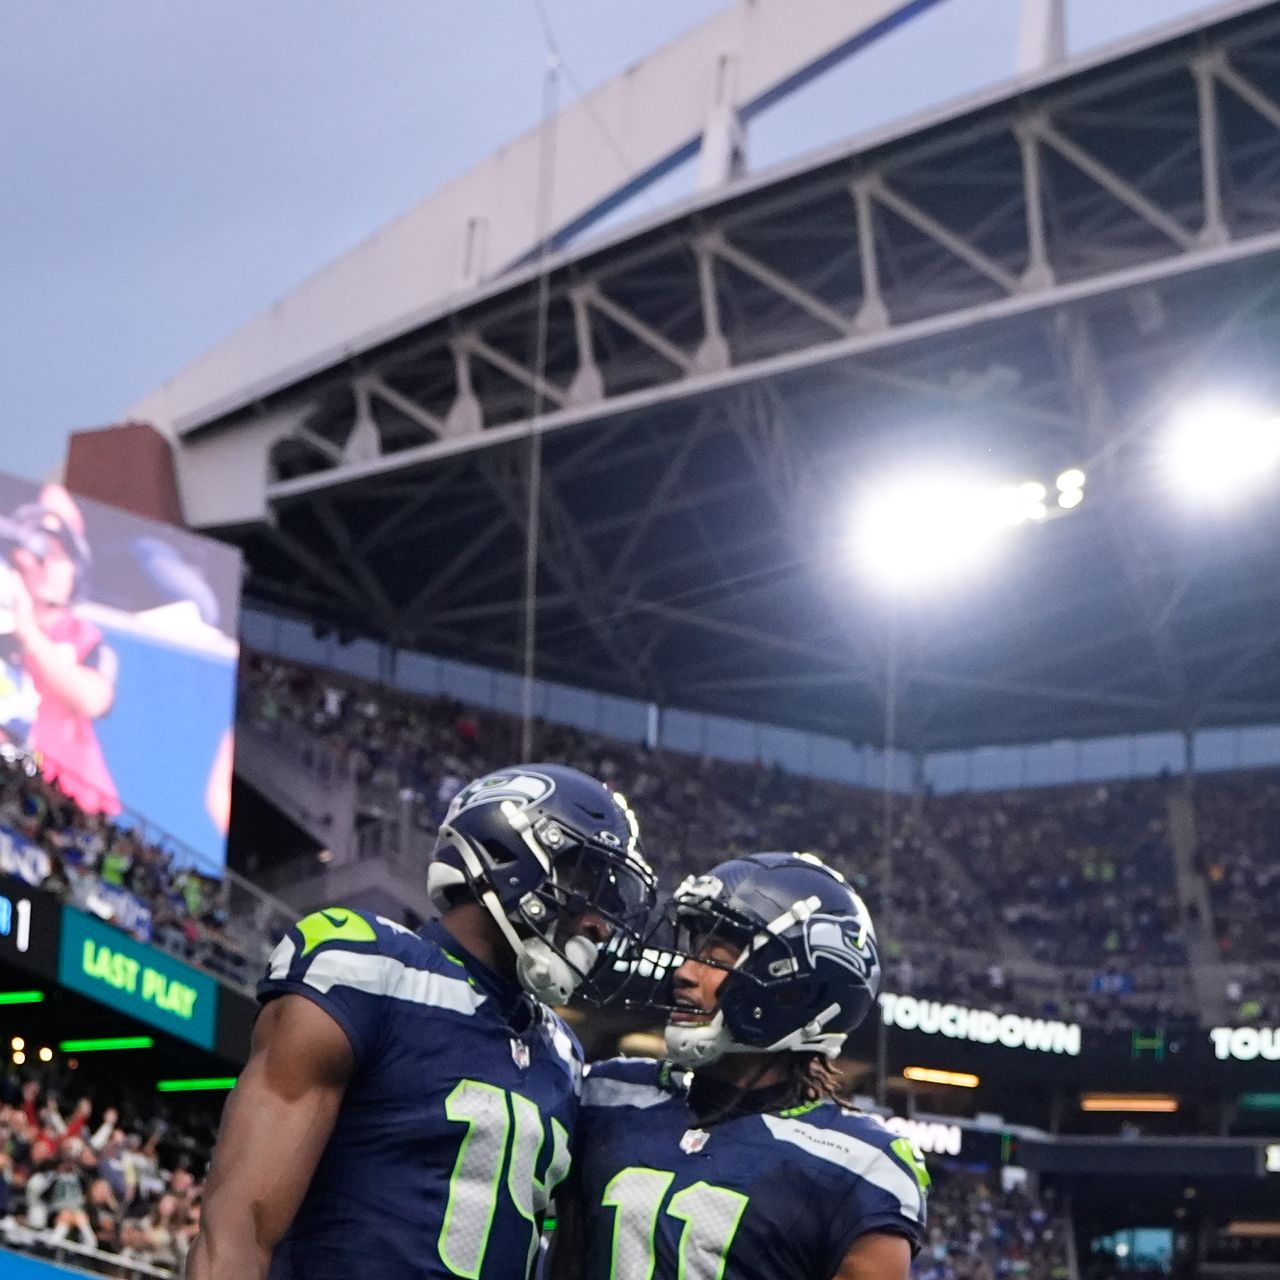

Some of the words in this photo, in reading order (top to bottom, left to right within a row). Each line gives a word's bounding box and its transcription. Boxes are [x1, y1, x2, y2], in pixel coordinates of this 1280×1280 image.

[16, 898, 31, 952] 1
[82, 938, 140, 995] LAST
[141, 967, 198, 1021] PLAY
[877, 991, 1082, 1056] TOUCHDOWN
[793, 1126, 851, 1155] SEAHAWKS
